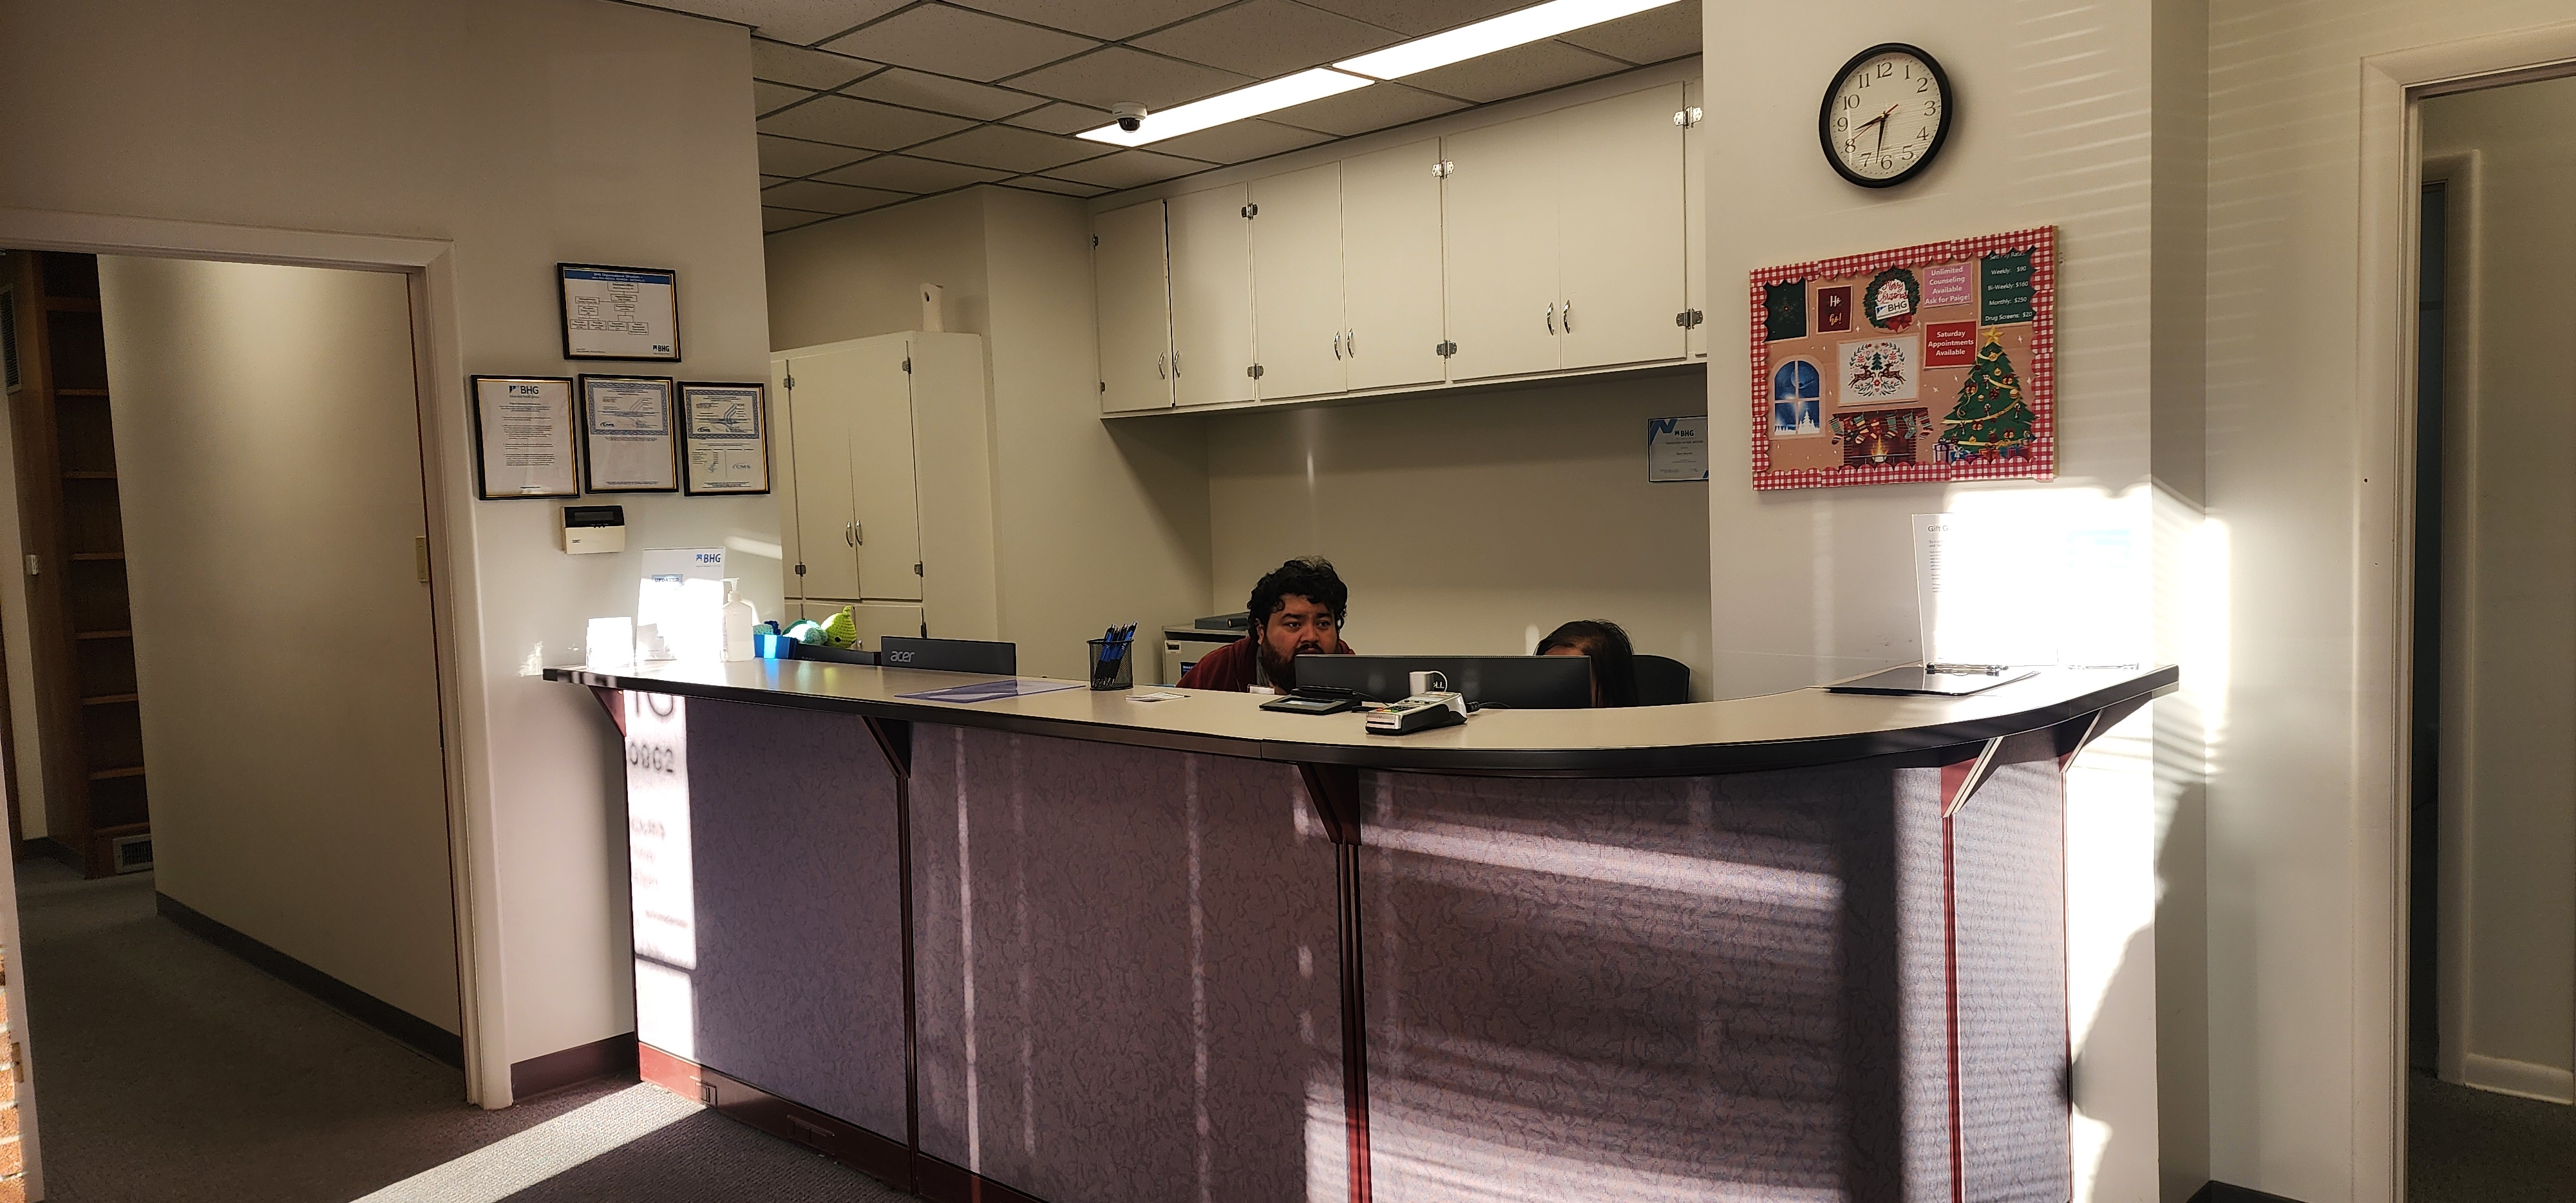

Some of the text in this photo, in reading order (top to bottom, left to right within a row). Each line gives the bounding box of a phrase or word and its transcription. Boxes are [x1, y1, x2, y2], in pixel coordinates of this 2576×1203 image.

[1876, 62, 1893, 79] 12
[1904, 64, 1911, 80] 1
[1859, 73, 1870, 89] 11
[1917, 77, 1927, 93] 2
[1842, 94, 1860, 110] 10
[1924, 100, 1936, 116] 3
[1837, 117, 1848, 132] 9
[1917, 126, 1929, 140] 4
[1844, 138, 1856, 153] 8
[1901, 145, 1914, 160] 5
[1860, 153, 1871, 167] 7
[1880, 155, 1893, 170] 6
[1931, 266, 1963, 276] Unlimited
[1929, 276, 1965, 286] Counseling
[1932, 285, 1962, 294] Available
[1949, 293, 1971, 304] Paige!
[1888, 301, 1908, 312] BHG
[1999, 312, 2020, 321] Screens:
[1937, 330, 1965, 338] Saturday
[1927, 339, 1975, 348] Appointments
[520, 385, 539, 395] BHG
[703, 553, 721, 564] BHG
[890, 650, 915, 663] acer
